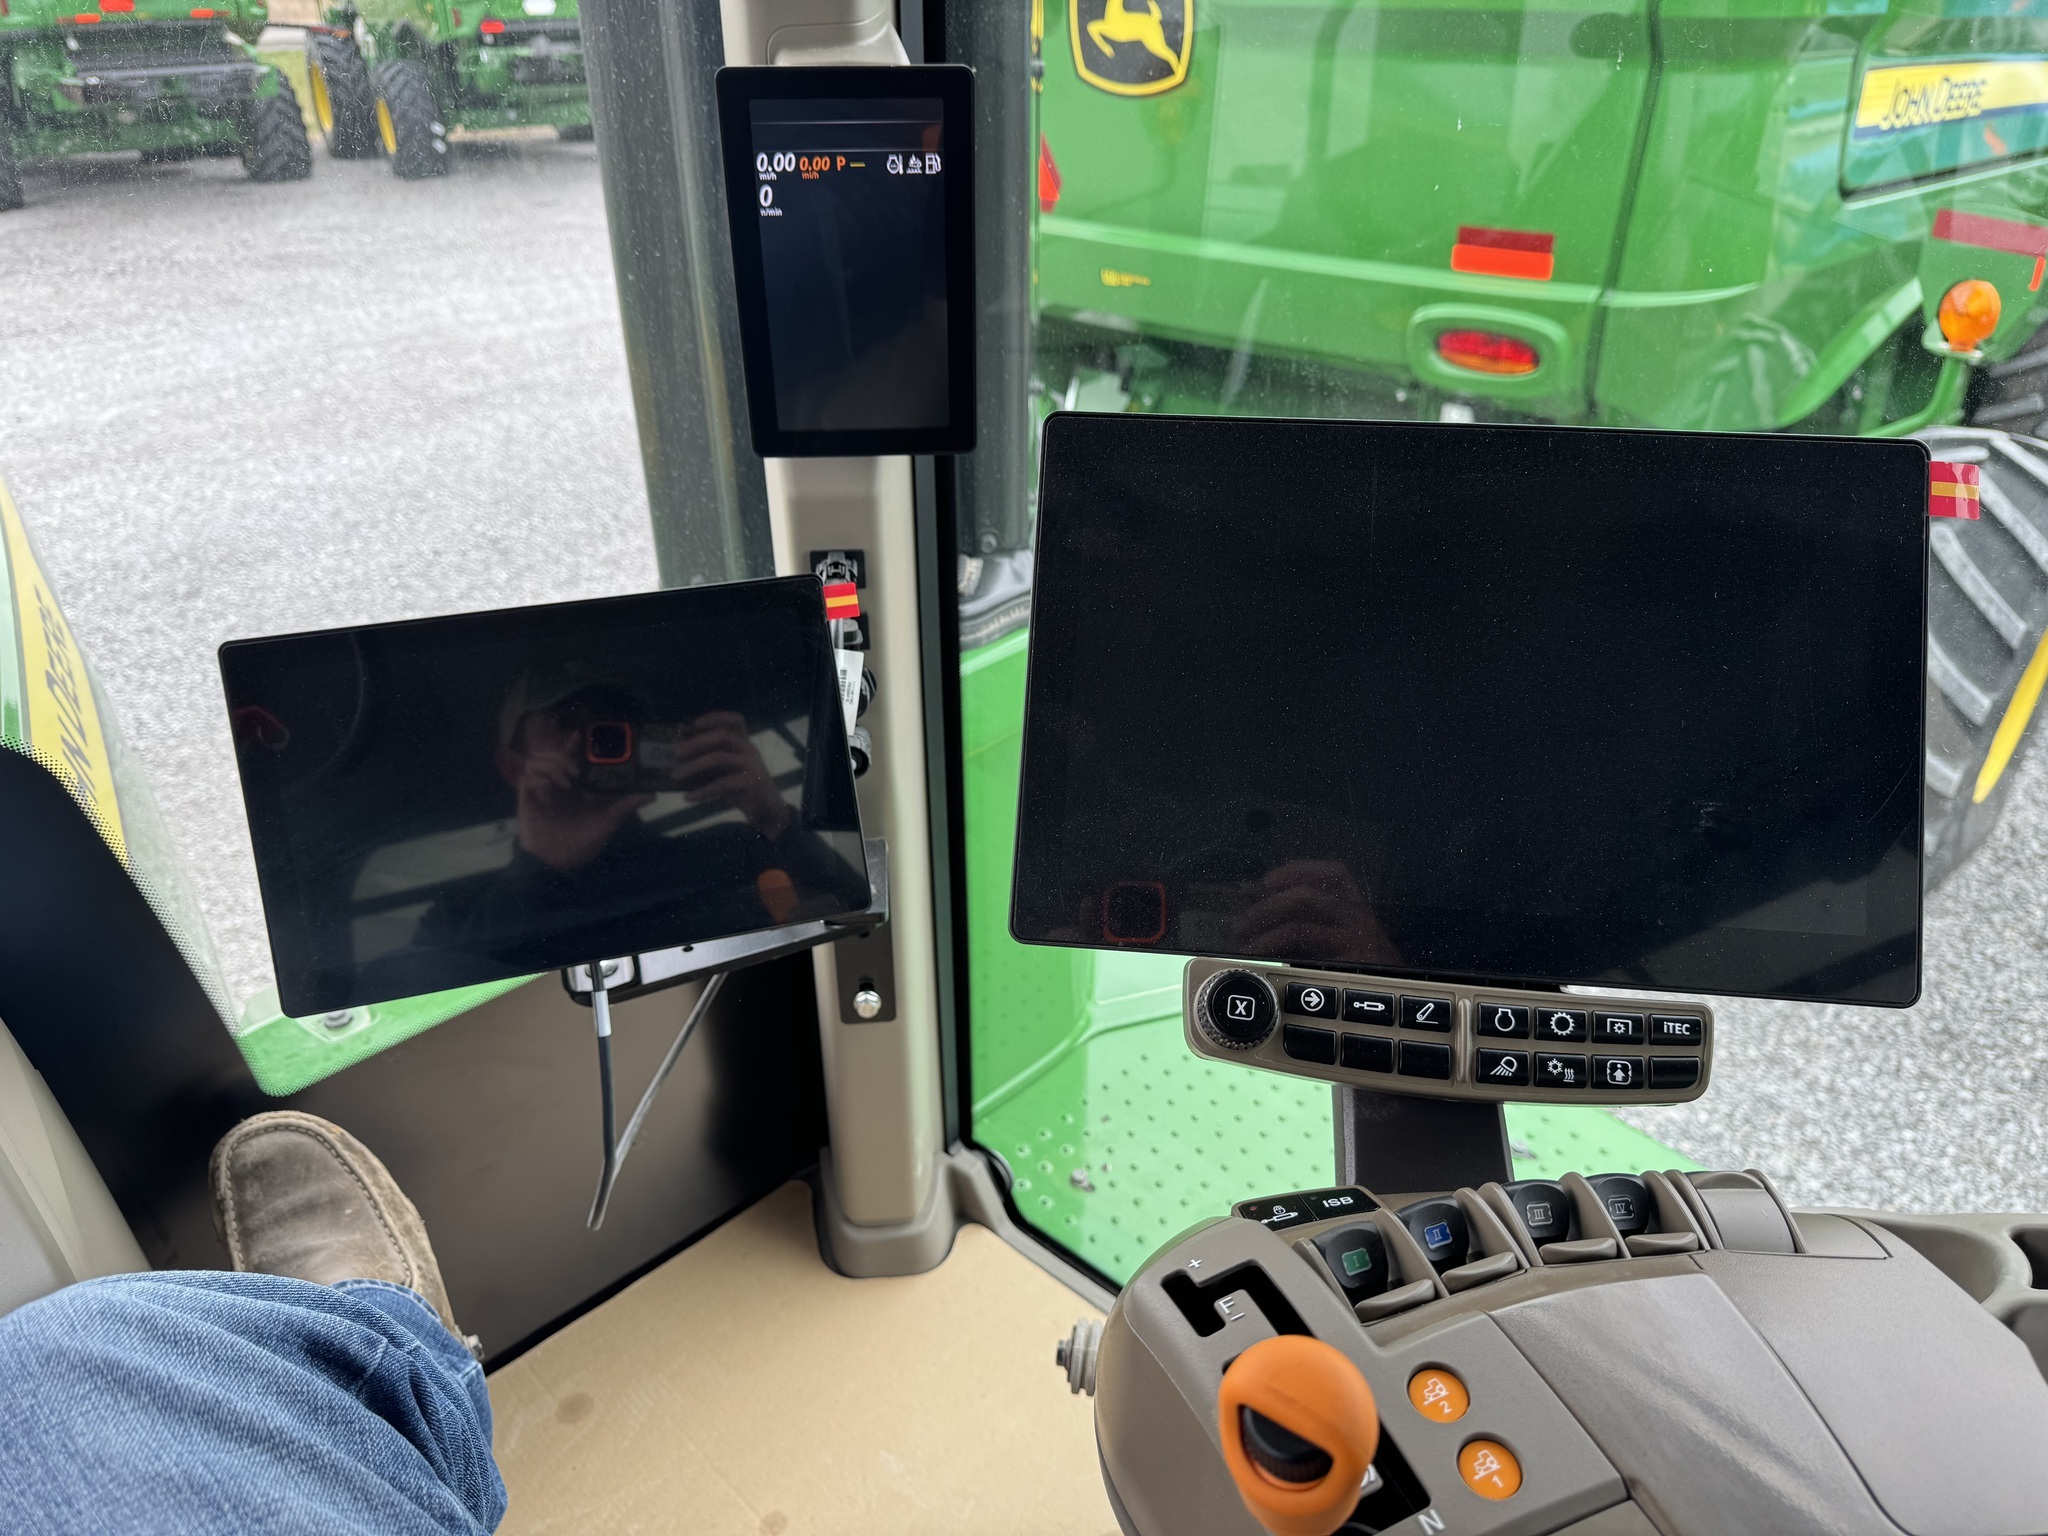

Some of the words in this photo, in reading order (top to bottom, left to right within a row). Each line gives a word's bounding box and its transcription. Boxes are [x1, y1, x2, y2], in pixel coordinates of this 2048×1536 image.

[1881, 79, 1936, 121] JOHN
[1933, 76, 1986, 115] DEERE
[756, 151, 796, 172] 0.00
[799, 156, 831, 171] 0.00
[836, 155, 846, 171] P
[759, 172, 777, 181] mi/h
[802, 171, 820, 180] mi/h
[759, 184, 773, 208] 0
[1663, 1021, 1691, 1035] iTEC
[1322, 1196, 1354, 1208] ISB
[1533, 1208, 1546, 1220] III
[1439, 1400, 1452, 1414] 2
[1492, 1474, 1504, 1488] 1
[1417, 1508, 1446, 1536] N
